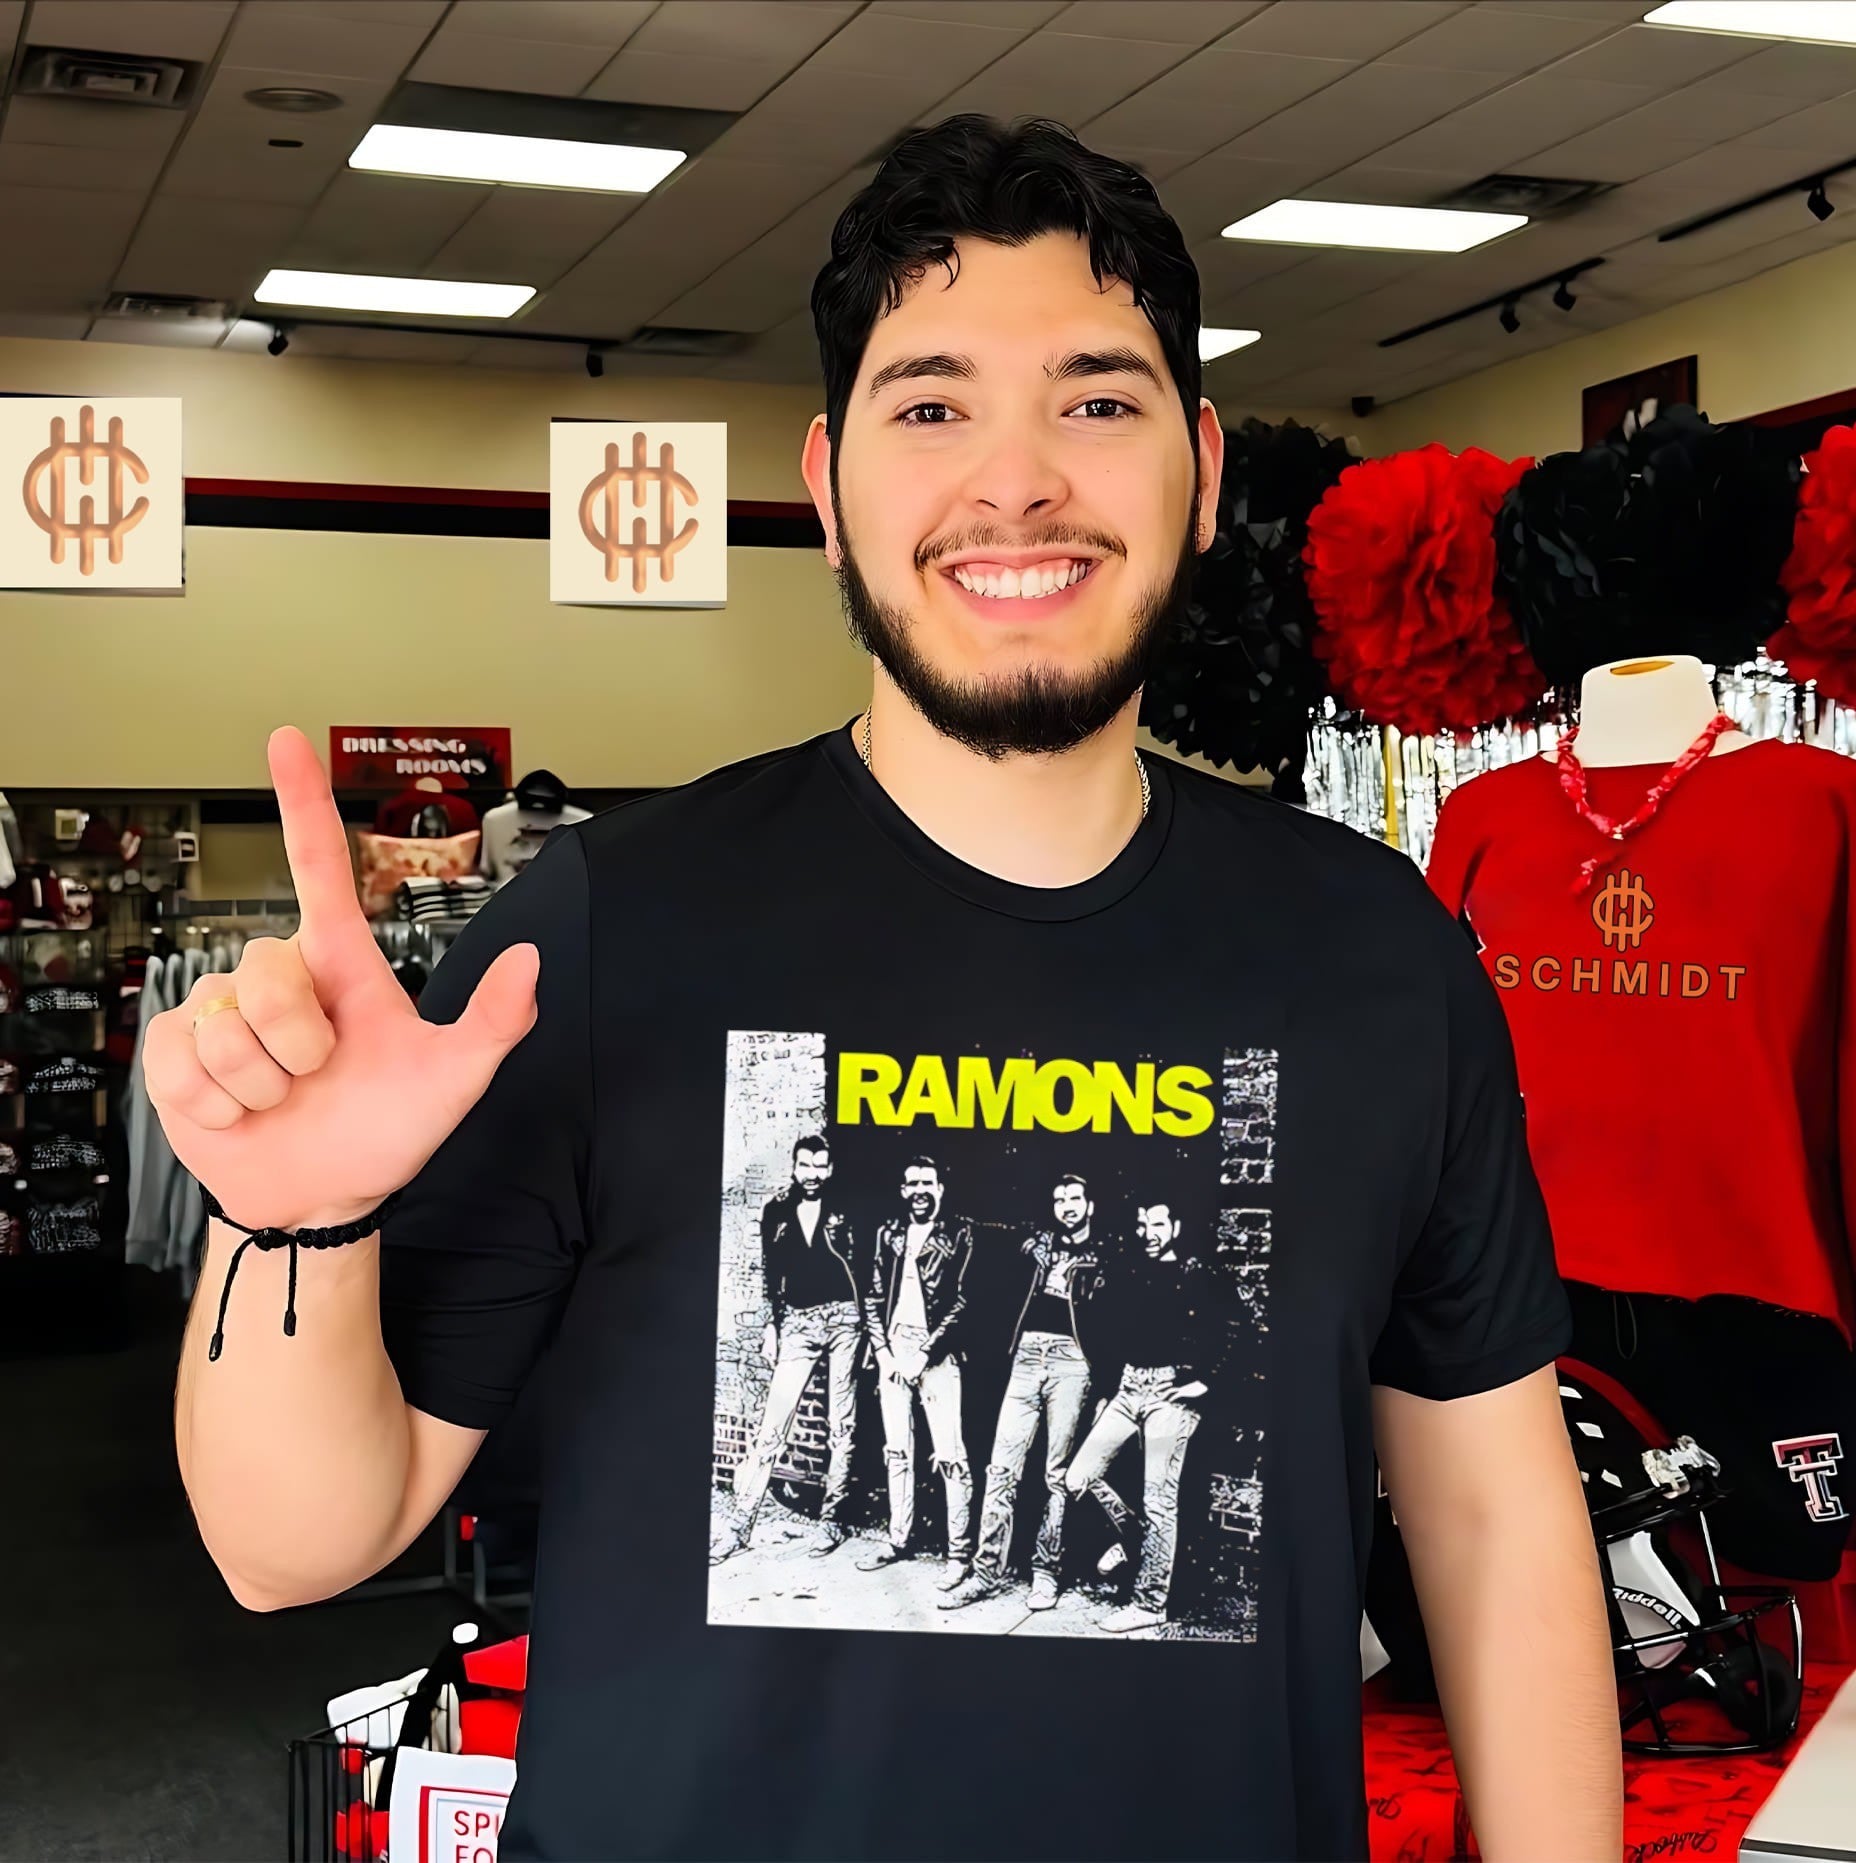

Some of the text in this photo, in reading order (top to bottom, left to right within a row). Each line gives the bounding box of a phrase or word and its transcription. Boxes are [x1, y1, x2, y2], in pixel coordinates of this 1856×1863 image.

[342, 737, 467, 754] DRESSING
[396, 758, 488, 775] ROOMS
[1494, 953, 1747, 1001] SCHMIDT
[836, 1051, 1215, 1138] RAMONS
